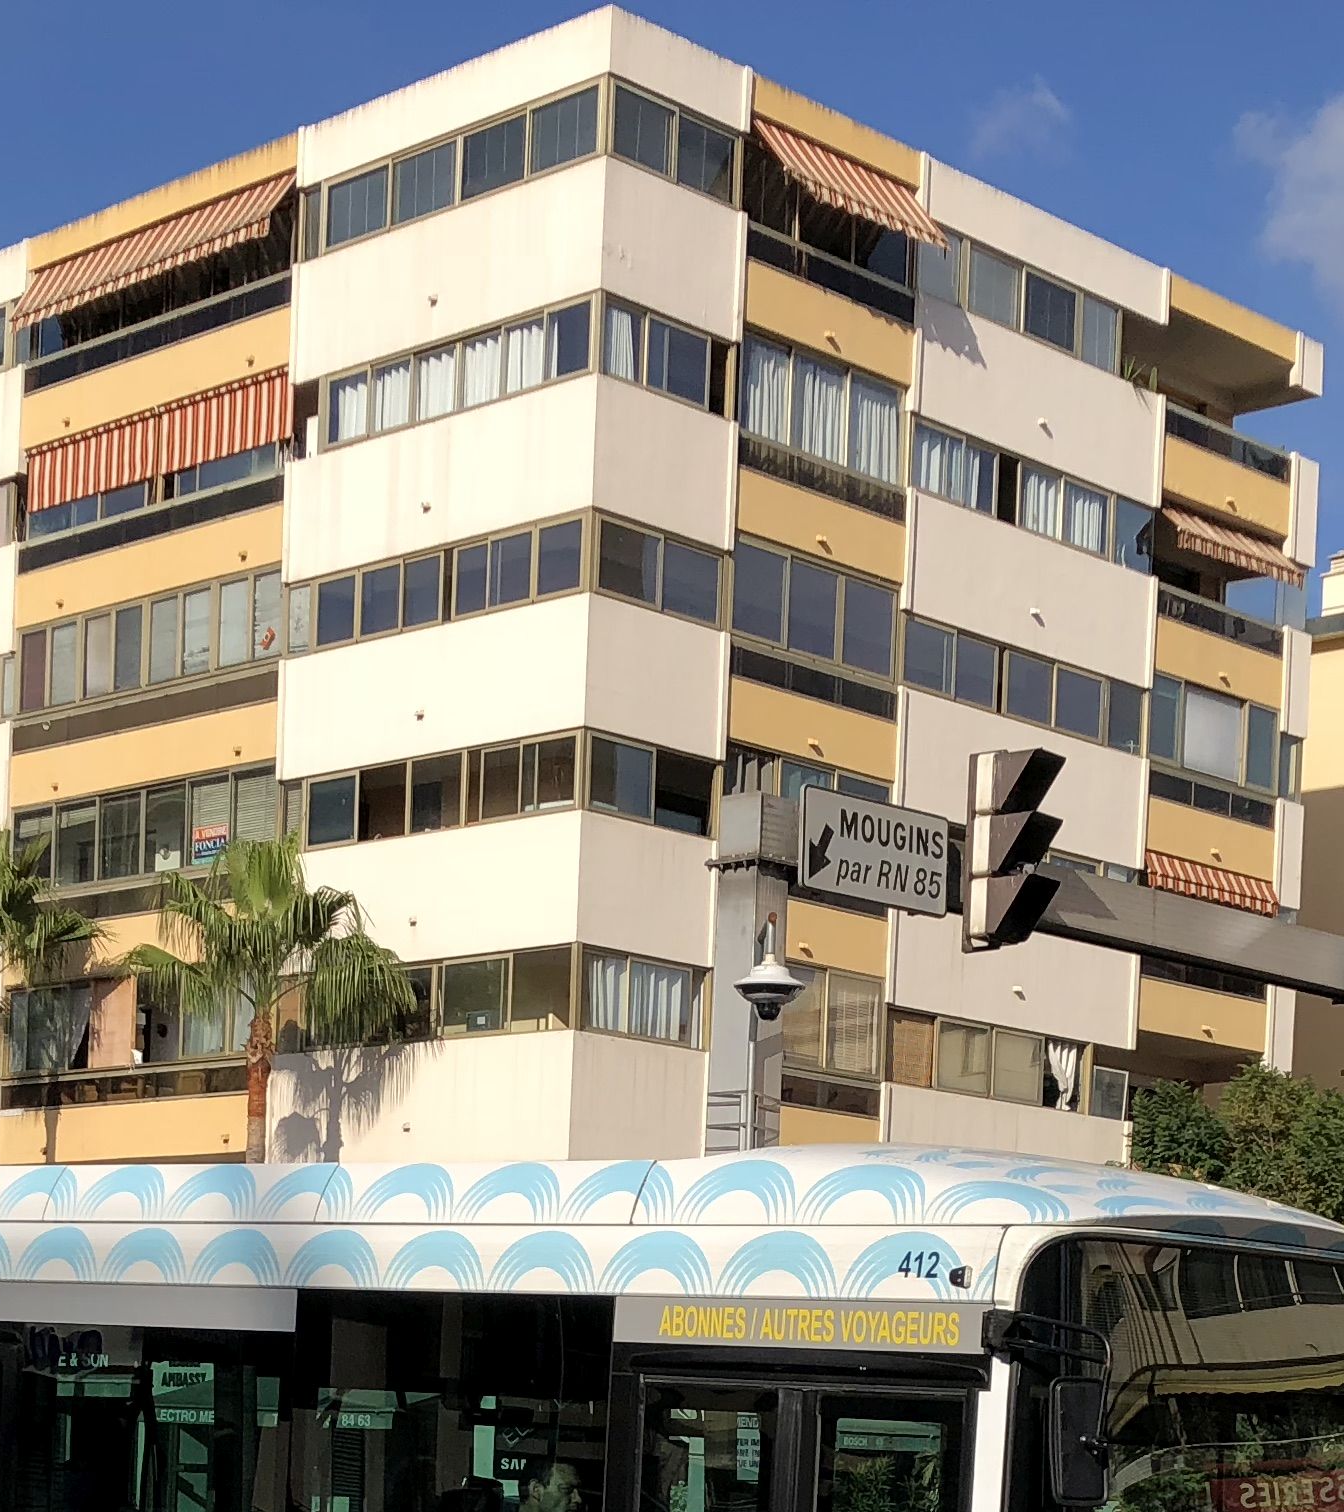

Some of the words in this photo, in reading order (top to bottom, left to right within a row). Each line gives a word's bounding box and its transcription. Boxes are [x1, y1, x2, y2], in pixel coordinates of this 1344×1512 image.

[840, 808, 944, 860] MOUGINS
[836, 858, 872, 887] par
[897, 1251, 940, 1279] 412
[659, 1305, 746, 1340] ABONNES
[759, 1308, 835, 1343] AUTRES
[840, 1310, 960, 1346] VOYAGEURS
